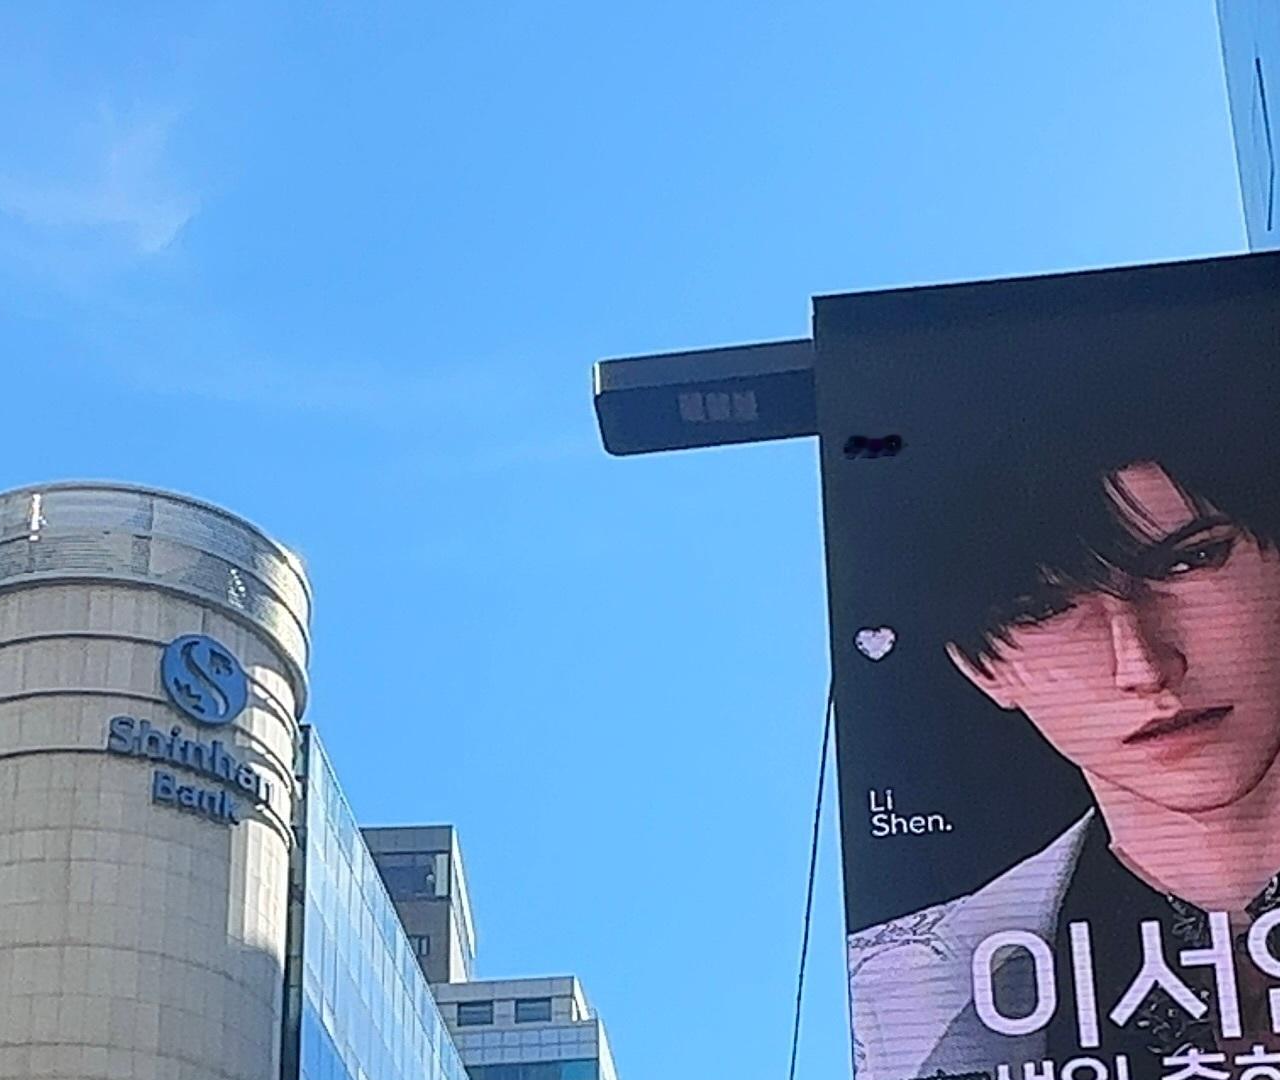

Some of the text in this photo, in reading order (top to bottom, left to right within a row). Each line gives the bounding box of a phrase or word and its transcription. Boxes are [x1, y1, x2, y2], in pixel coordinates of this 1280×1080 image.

[108, 716, 271, 803] Shinhan
[152, 770, 239, 826] Bank
[870, 789, 893, 811] Li
[871, 808, 953, 837] Shen.
